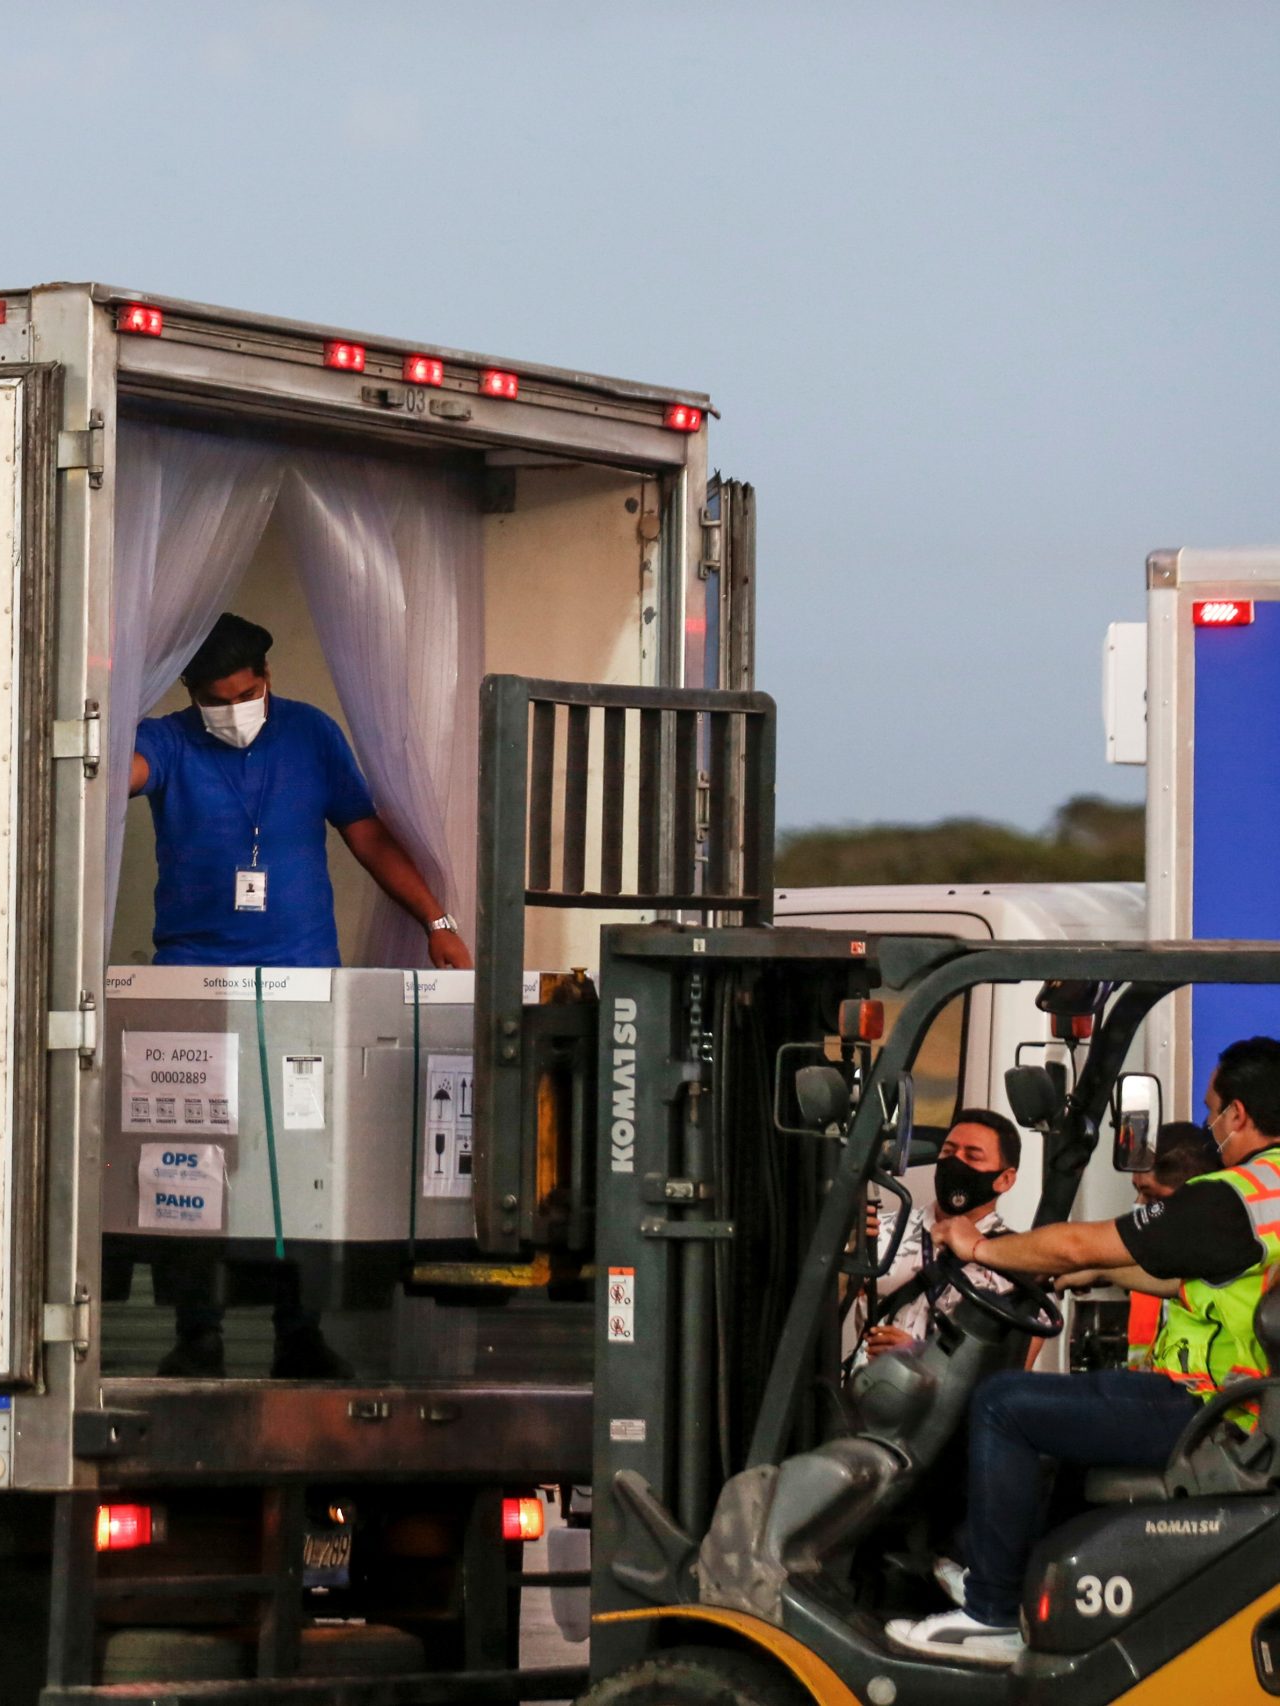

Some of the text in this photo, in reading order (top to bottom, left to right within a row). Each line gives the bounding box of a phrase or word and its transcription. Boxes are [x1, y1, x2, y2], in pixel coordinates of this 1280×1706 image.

[406, 387, 426, 413] 03
[203, 977, 287, 990] Softbox Silerpod
[146, 1048, 165, 1062] PO:
[151, 1070, 207, 1084] 00002889
[611, 997, 638, 1173] KOMATSU
[162, 1151, 198, 1168] OPS
[155, 1192, 205, 1209] PAHO
[1145, 1519, 1220, 1534] KOMATSU
[1075, 1574, 1134, 1617] 30
